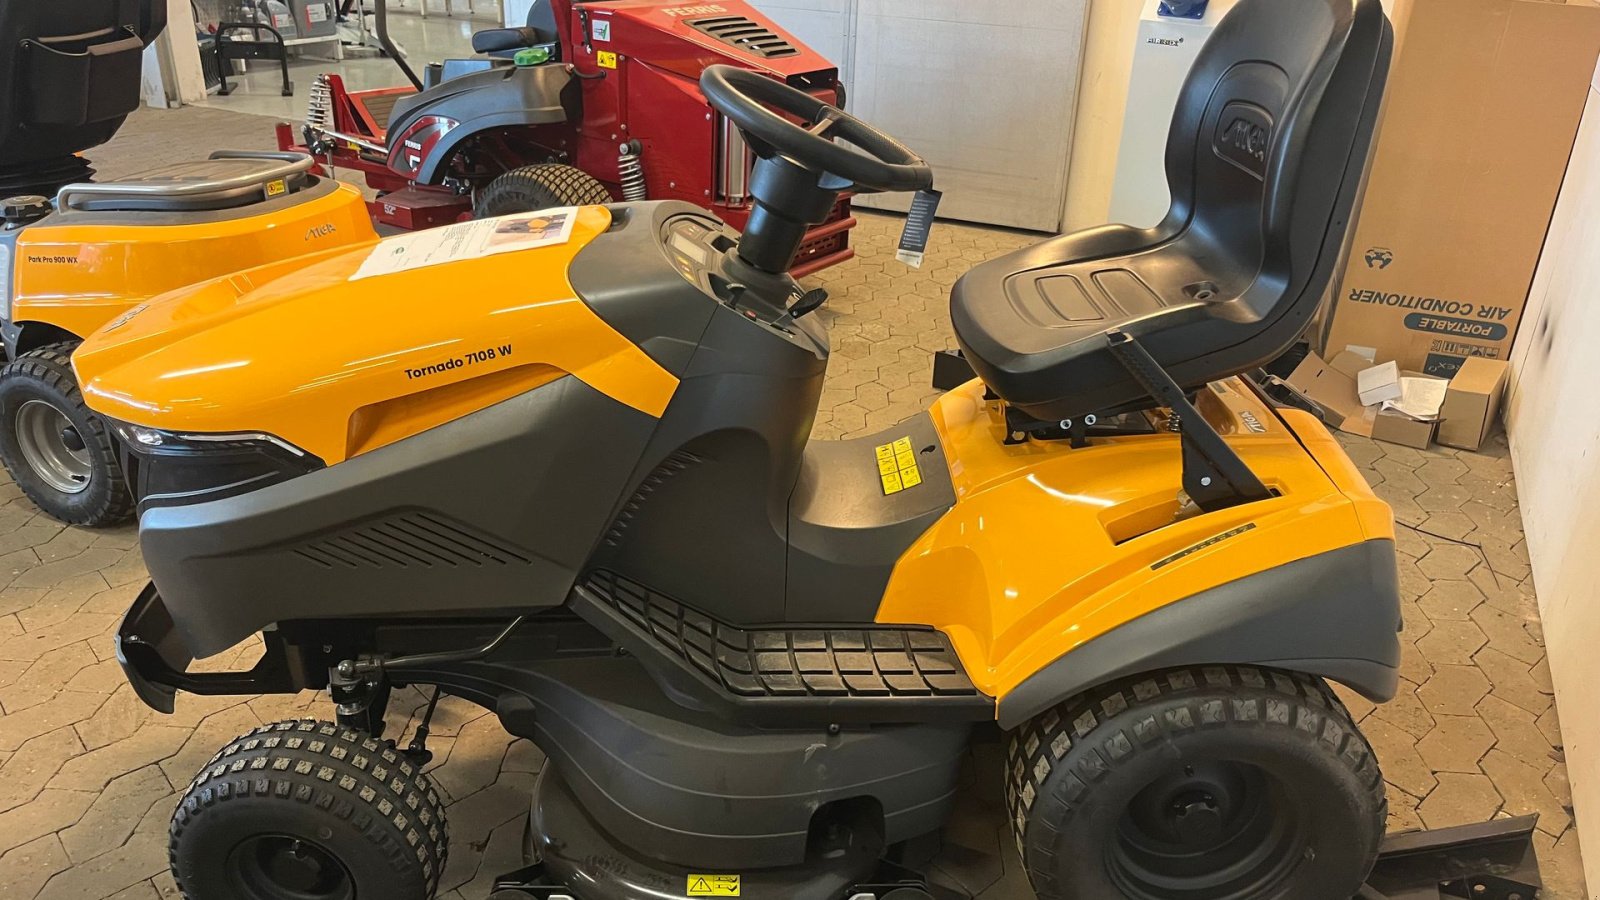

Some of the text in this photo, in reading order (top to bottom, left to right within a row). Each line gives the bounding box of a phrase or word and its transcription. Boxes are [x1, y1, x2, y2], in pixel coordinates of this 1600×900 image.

[661, 4, 728, 16] FERRIS
[405, 139, 421, 150] FERRIS
[42, 256, 53, 264] Pro
[53, 256, 66, 264] 900
[66, 256, 78, 264] WX
[1348, 288, 1512, 320] AIR CONDITIONER
[1418, 317, 1493, 336] PORTABLE
[404, 344, 512, 380] Tornado 7108 W
